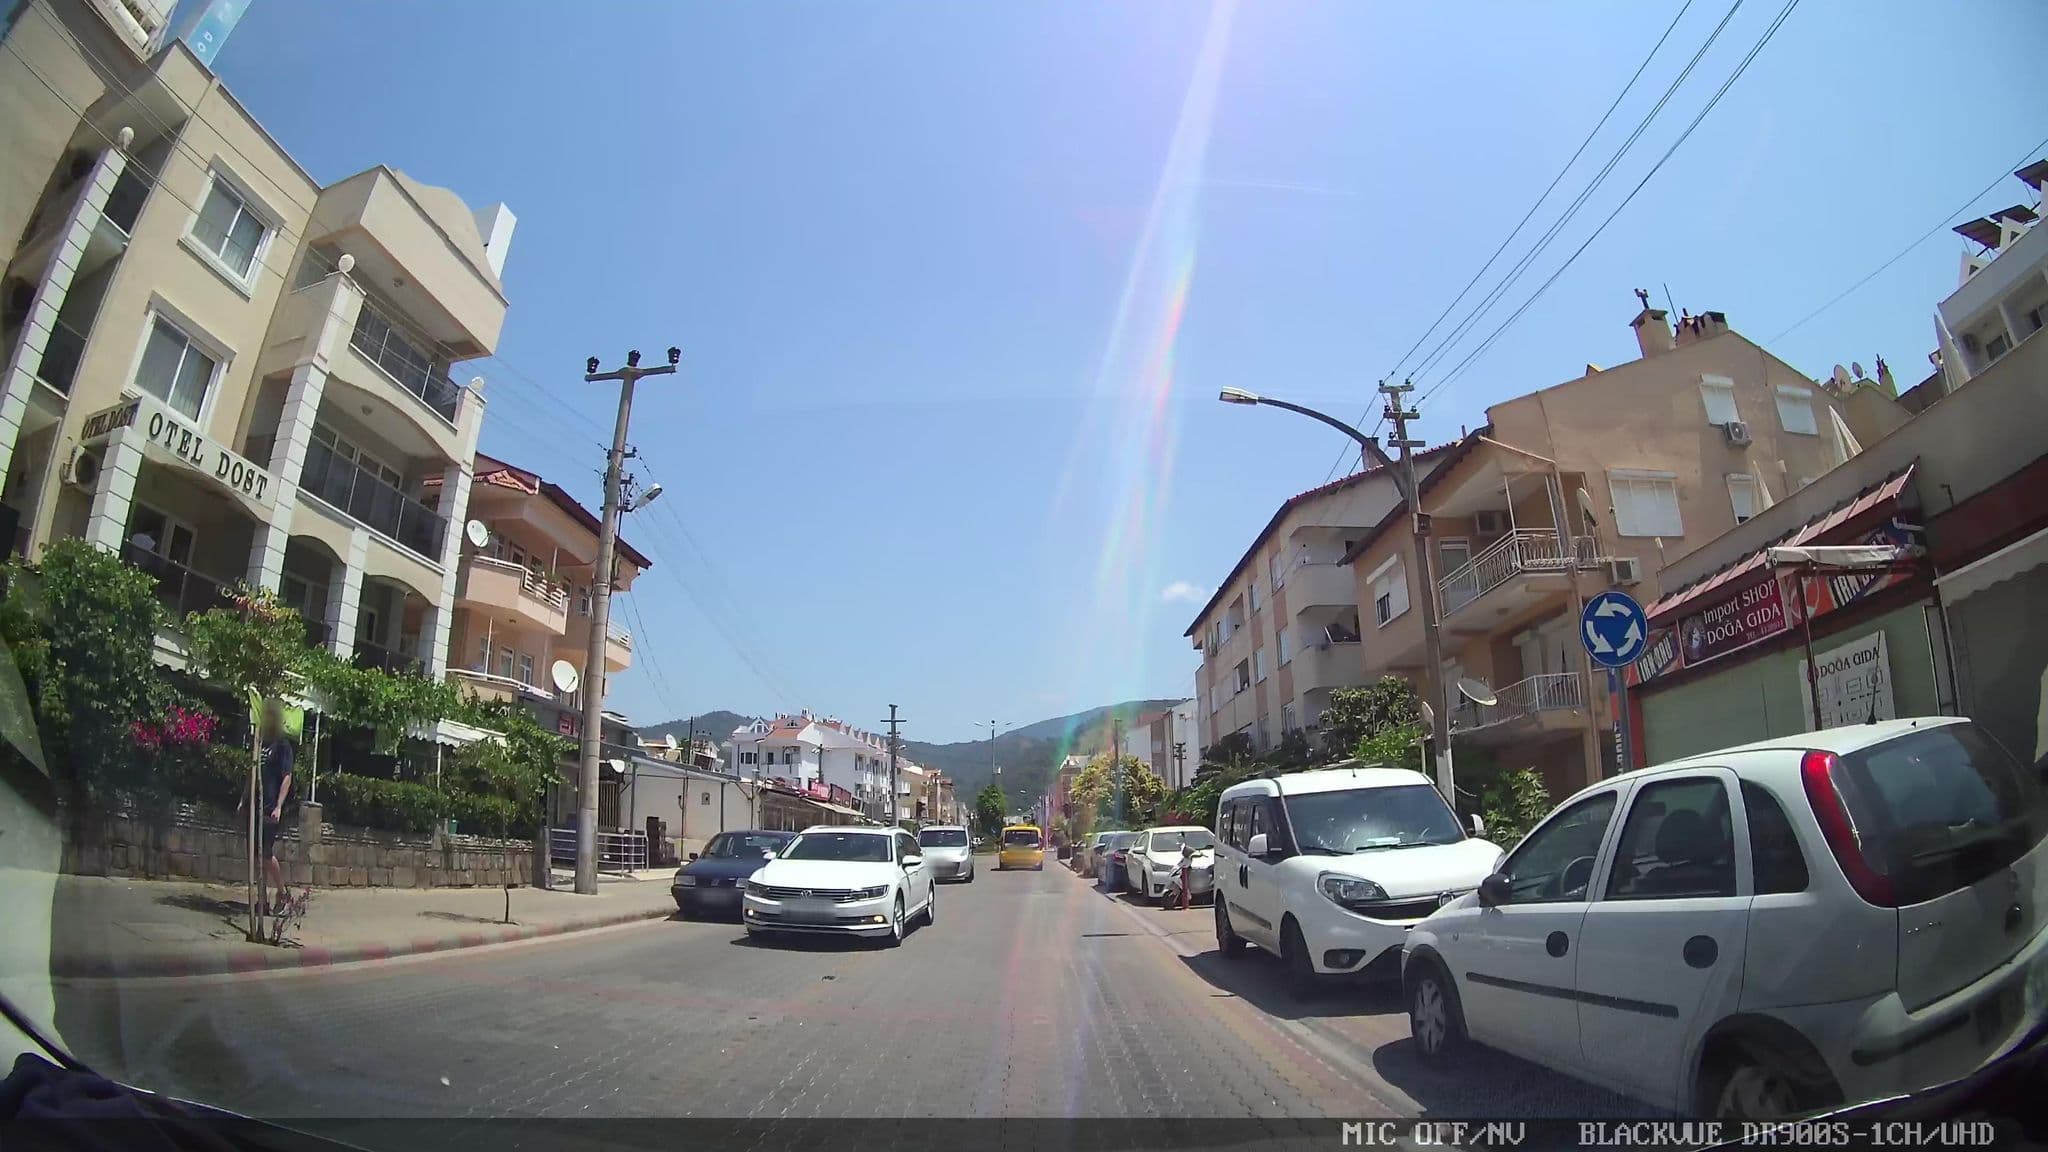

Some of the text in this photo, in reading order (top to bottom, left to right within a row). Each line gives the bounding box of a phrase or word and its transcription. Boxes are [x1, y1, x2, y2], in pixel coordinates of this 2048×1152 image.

[149, 412, 268, 499] OTEL DOST
[1703, 579, 1776, 624] Import SHOP
[1746, 603, 1781, 628] GIDA
[1853, 646, 1880, 666] GIDA
